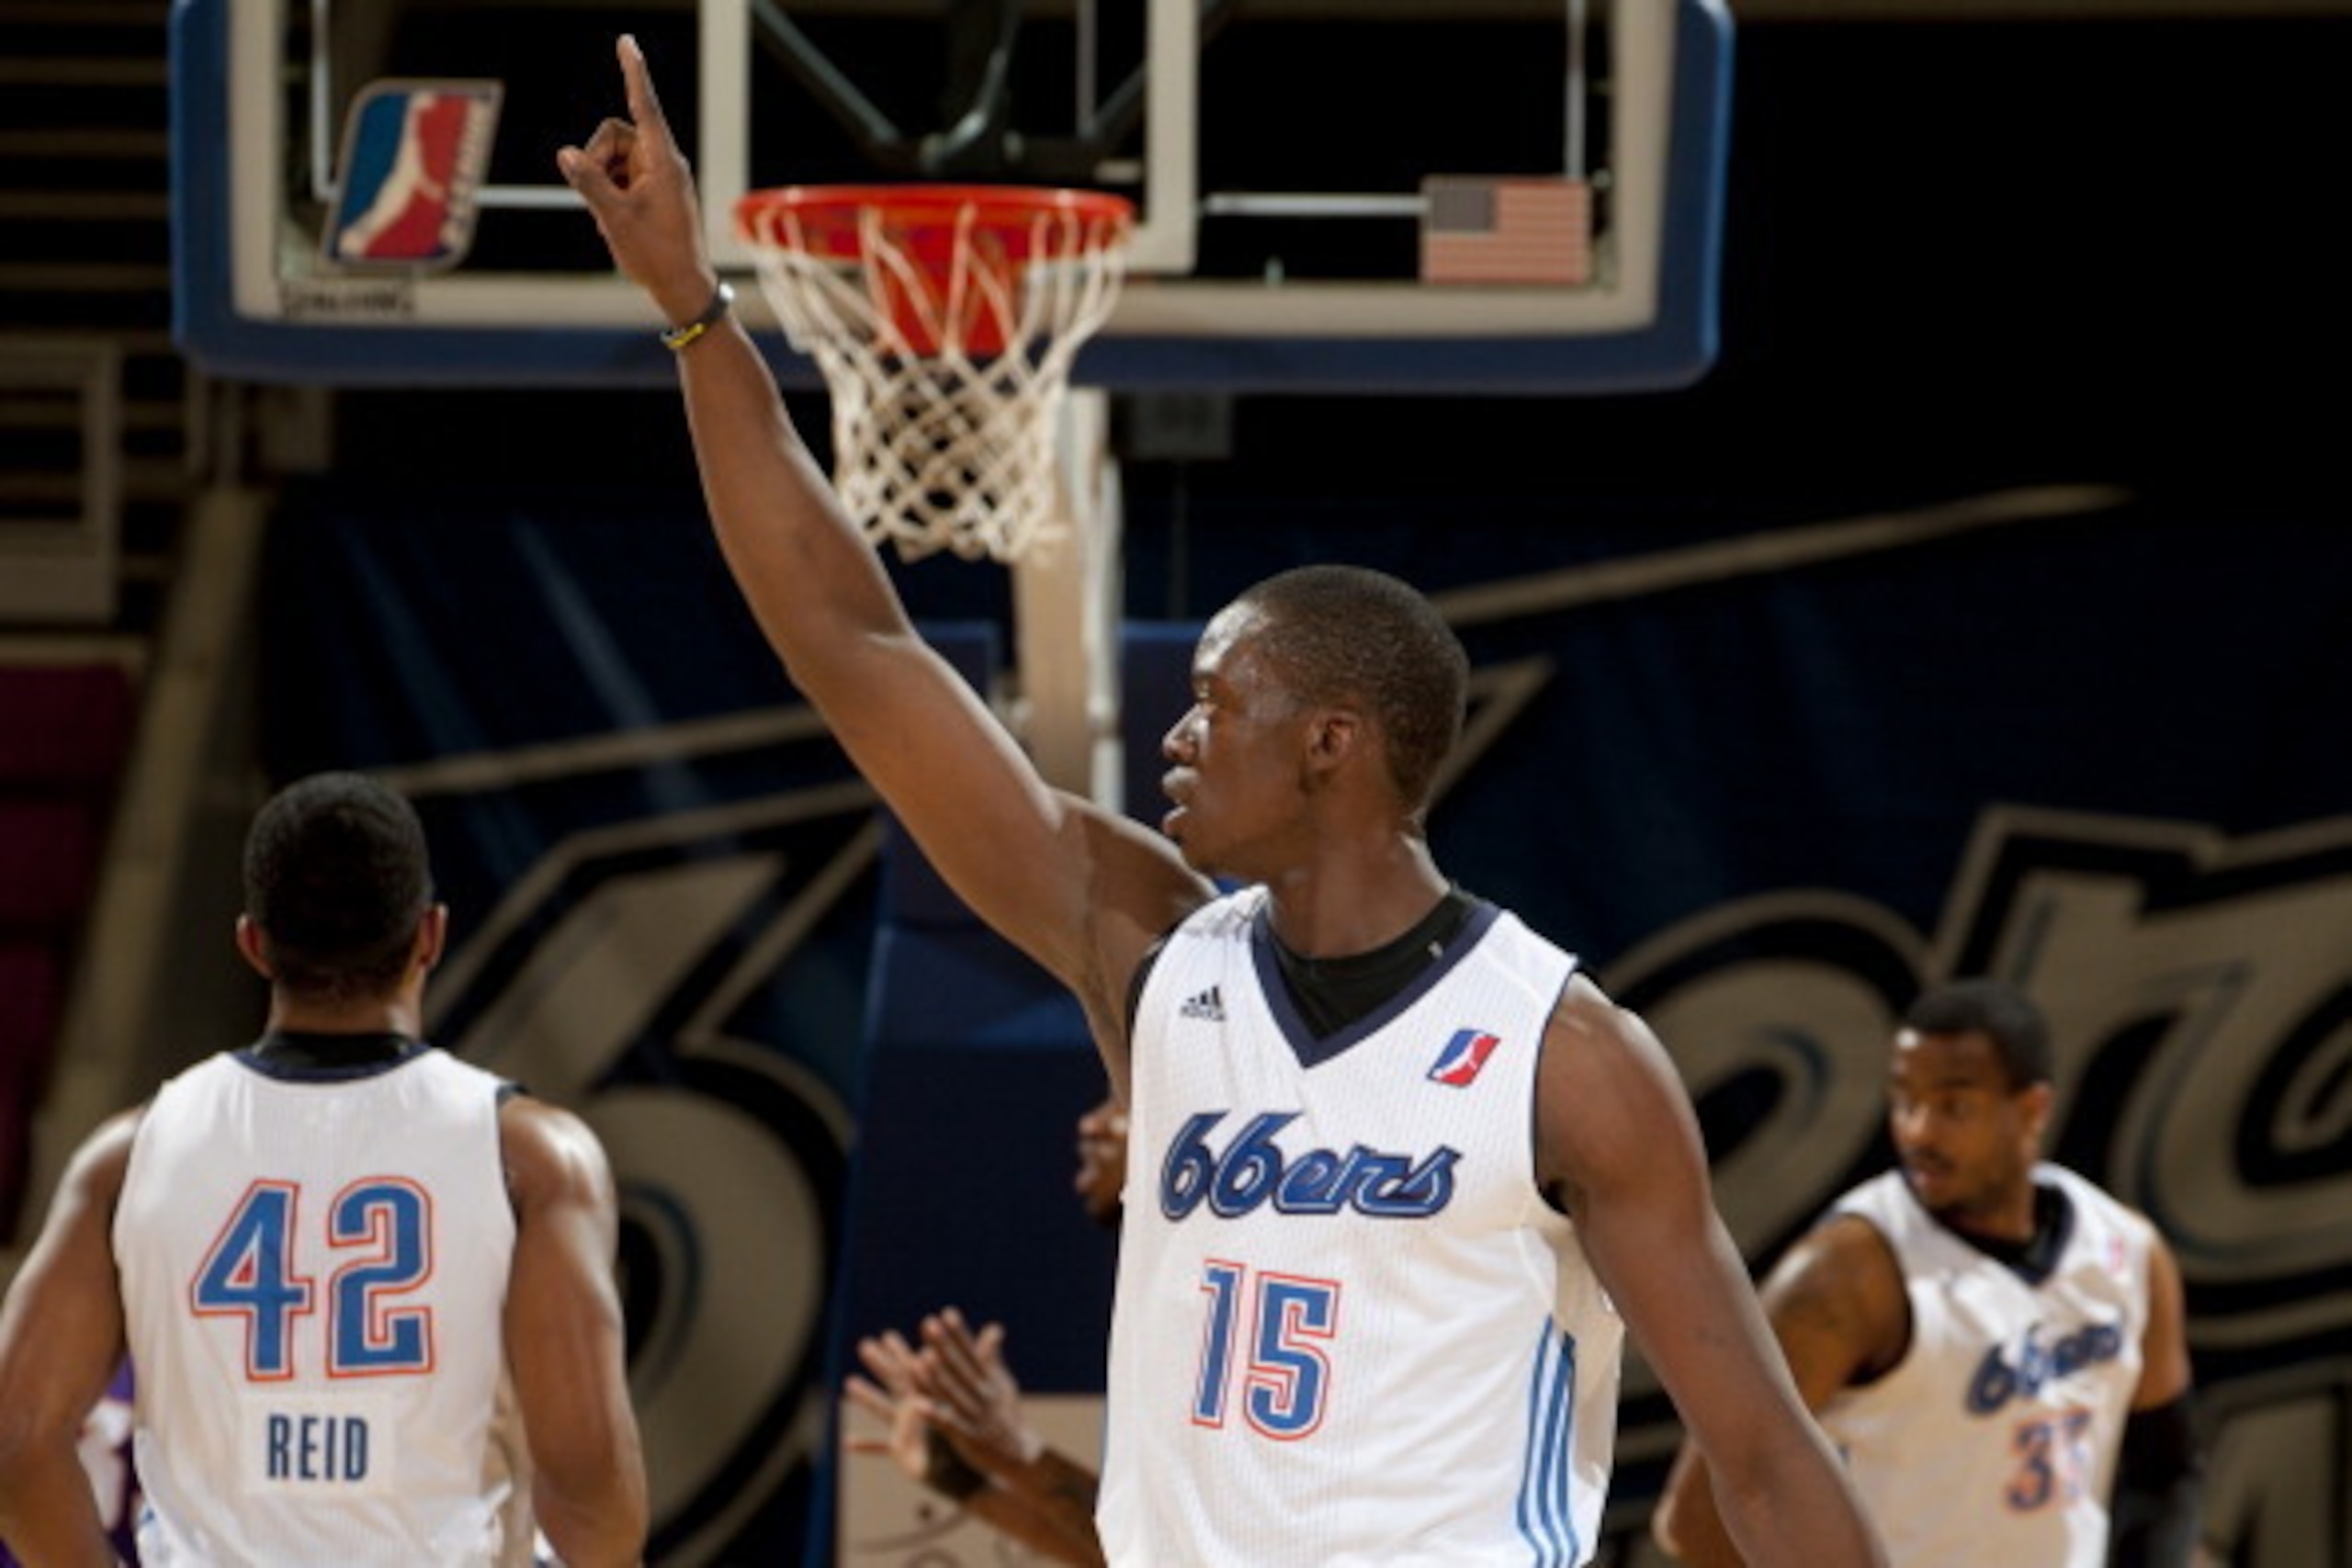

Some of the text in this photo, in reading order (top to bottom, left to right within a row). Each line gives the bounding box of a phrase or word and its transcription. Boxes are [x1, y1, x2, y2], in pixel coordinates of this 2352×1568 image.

[1160, 1110, 1464, 1223] 66ers
[191, 1175, 435, 1381] 42
[1192, 1258, 1342, 1441] 15
[266, 1413, 369, 1481] REID
